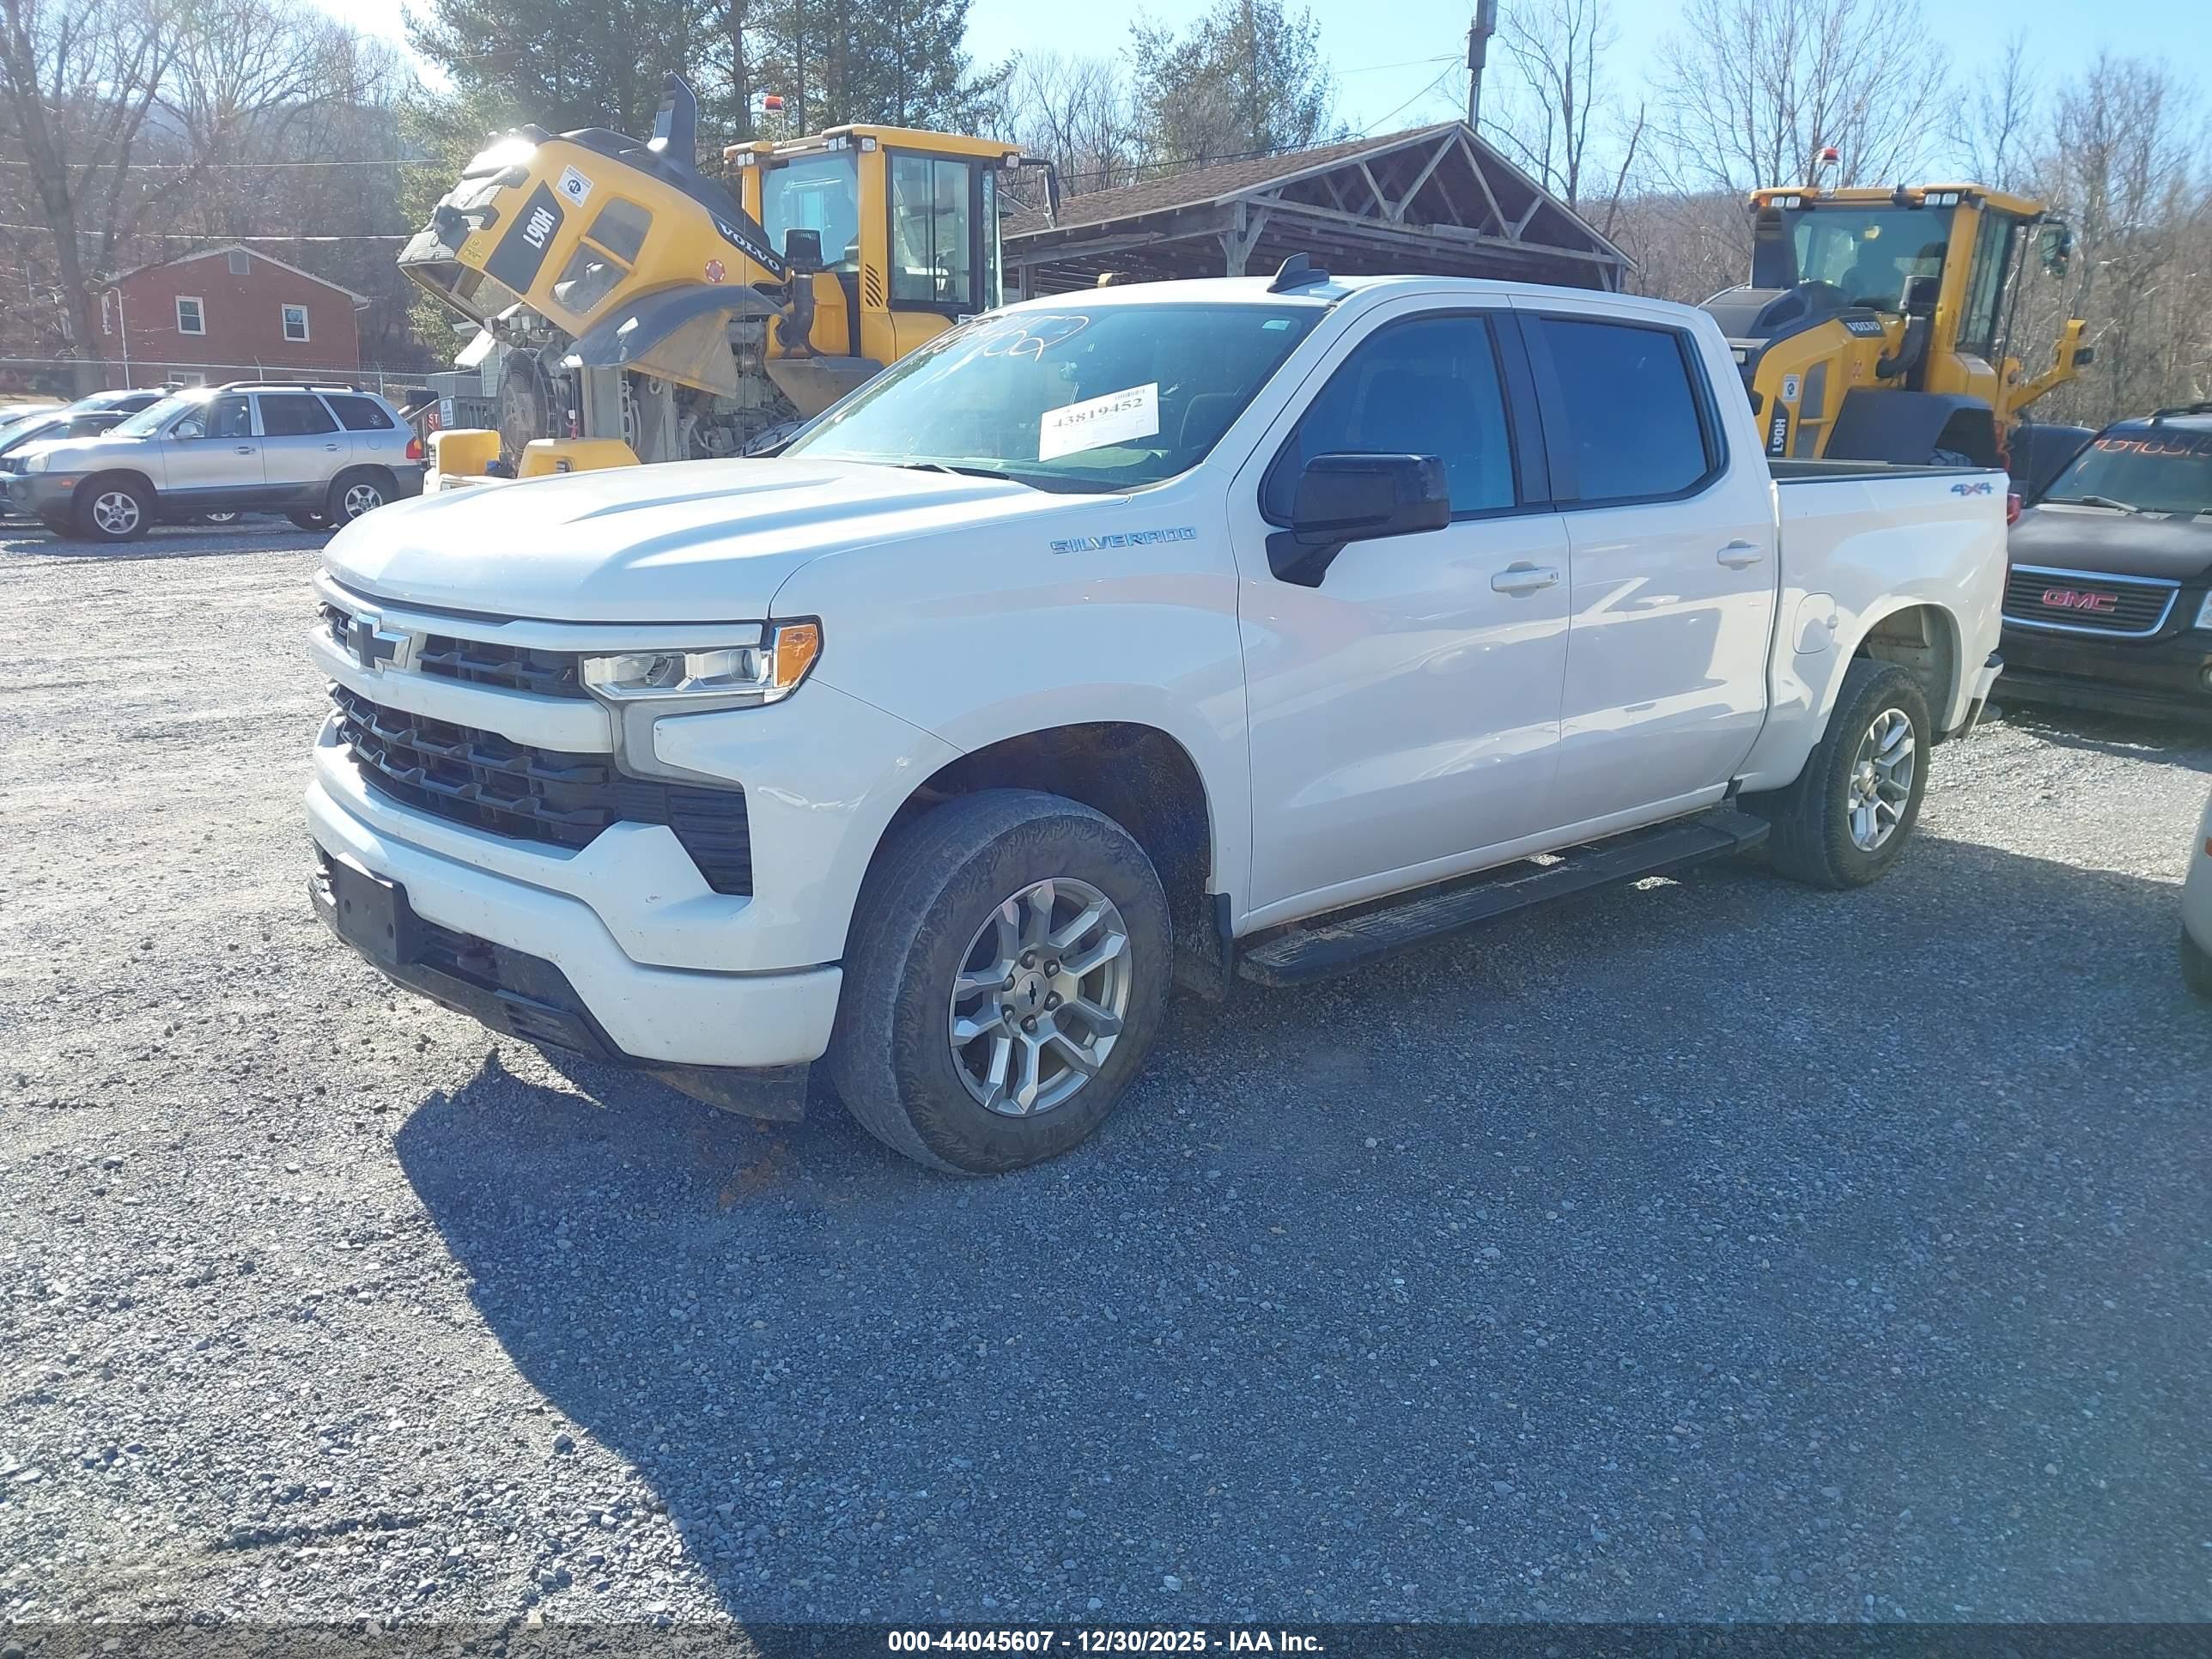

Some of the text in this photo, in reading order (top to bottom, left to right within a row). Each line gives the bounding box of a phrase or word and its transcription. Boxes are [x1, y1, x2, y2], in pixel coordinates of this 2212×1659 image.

[522, 206, 556, 249] L90H
[718, 221, 781, 271] VOLVO
[1847, 320, 1881, 332] VOLVO
[1052, 398, 1144, 428] 43819452
[1772, 418, 1787, 453] L90H
[1050, 526, 1197, 555] SILVERADO
[2043, 589, 2118, 612] GMC
